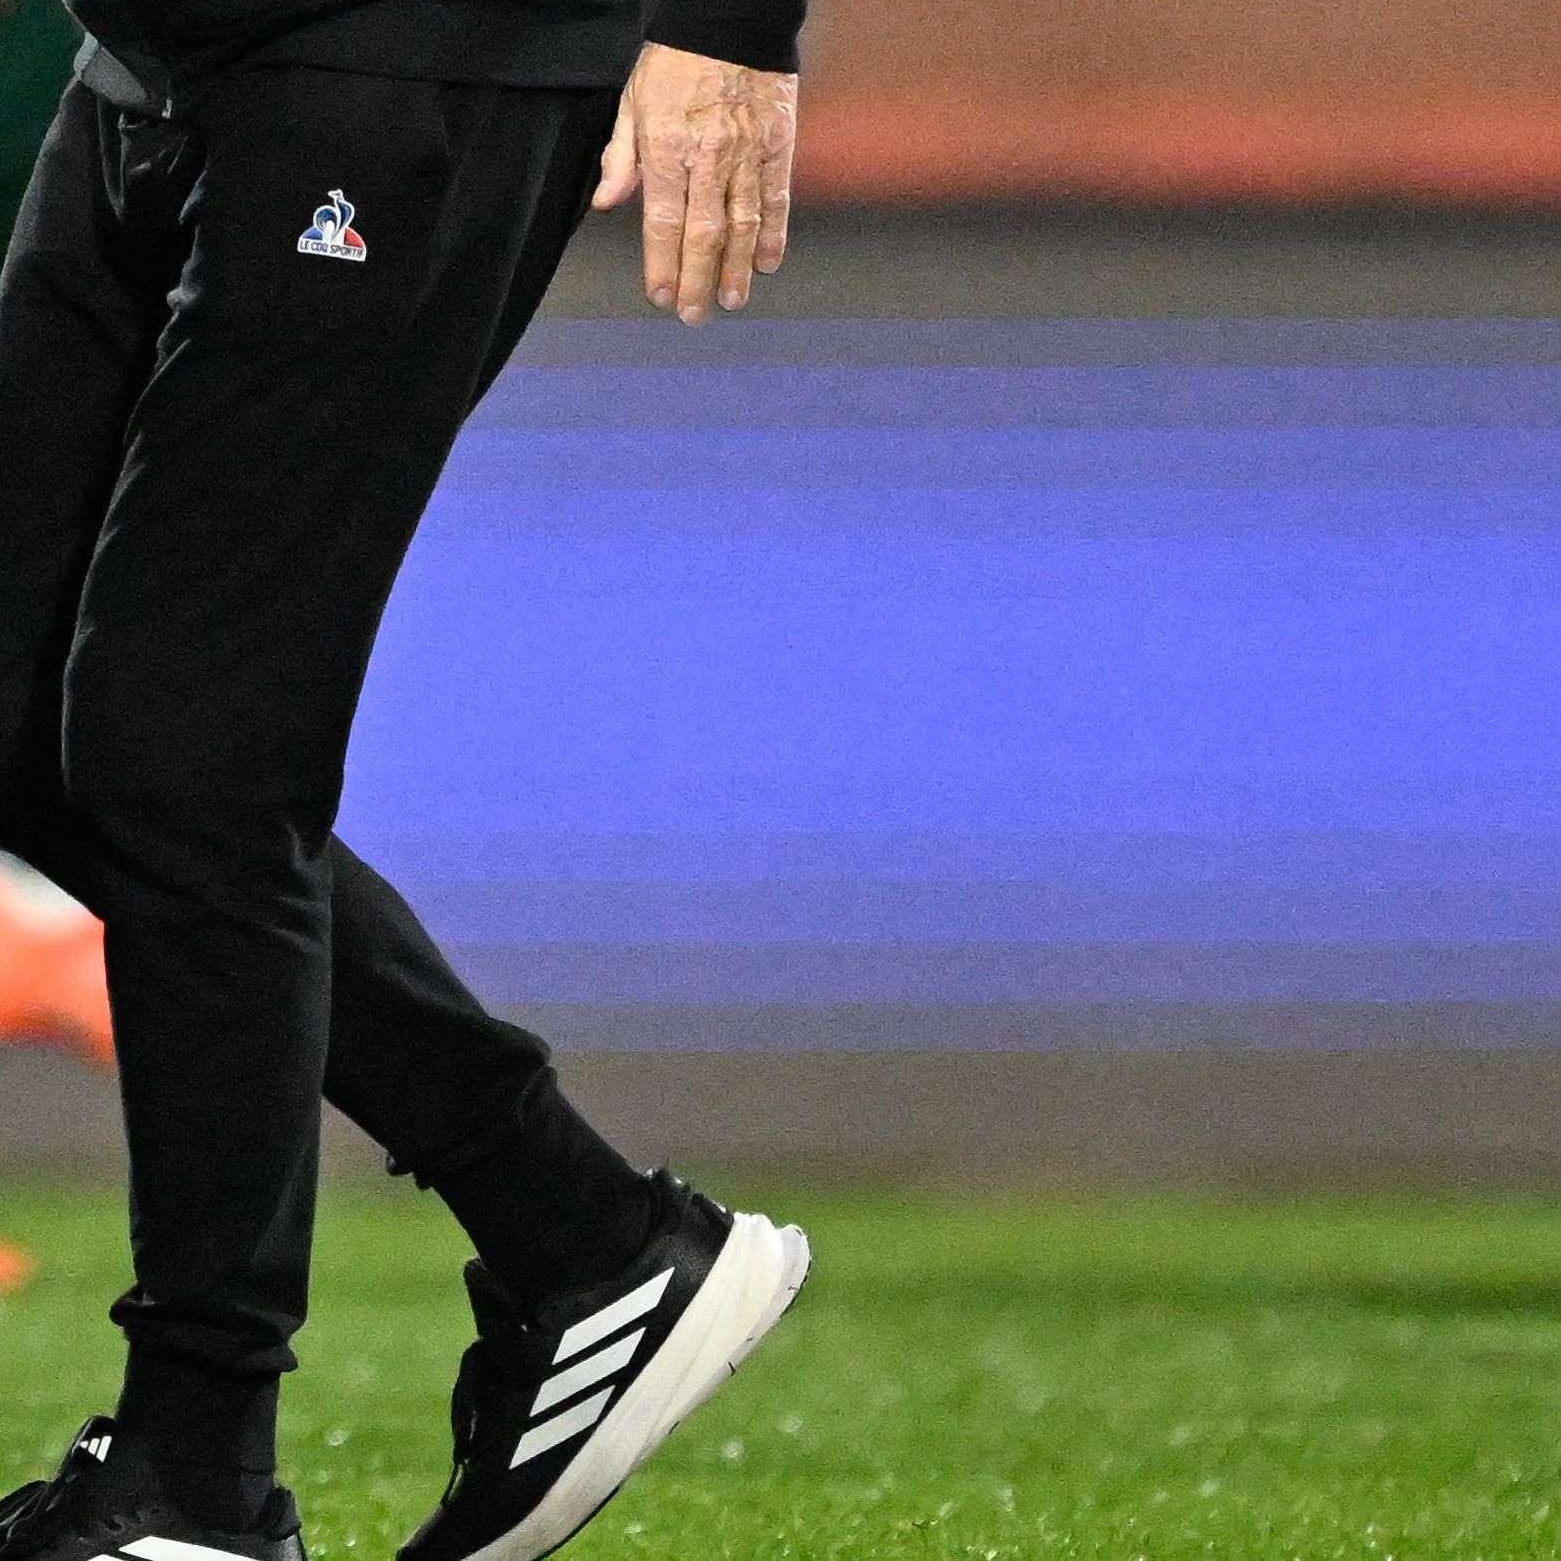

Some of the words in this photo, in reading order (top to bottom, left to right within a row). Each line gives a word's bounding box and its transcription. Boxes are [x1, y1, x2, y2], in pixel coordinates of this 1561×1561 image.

[299, 239, 310, 250] LE
[311, 241, 329, 253] COQ
[329, 243, 364, 258] SPORTIF
